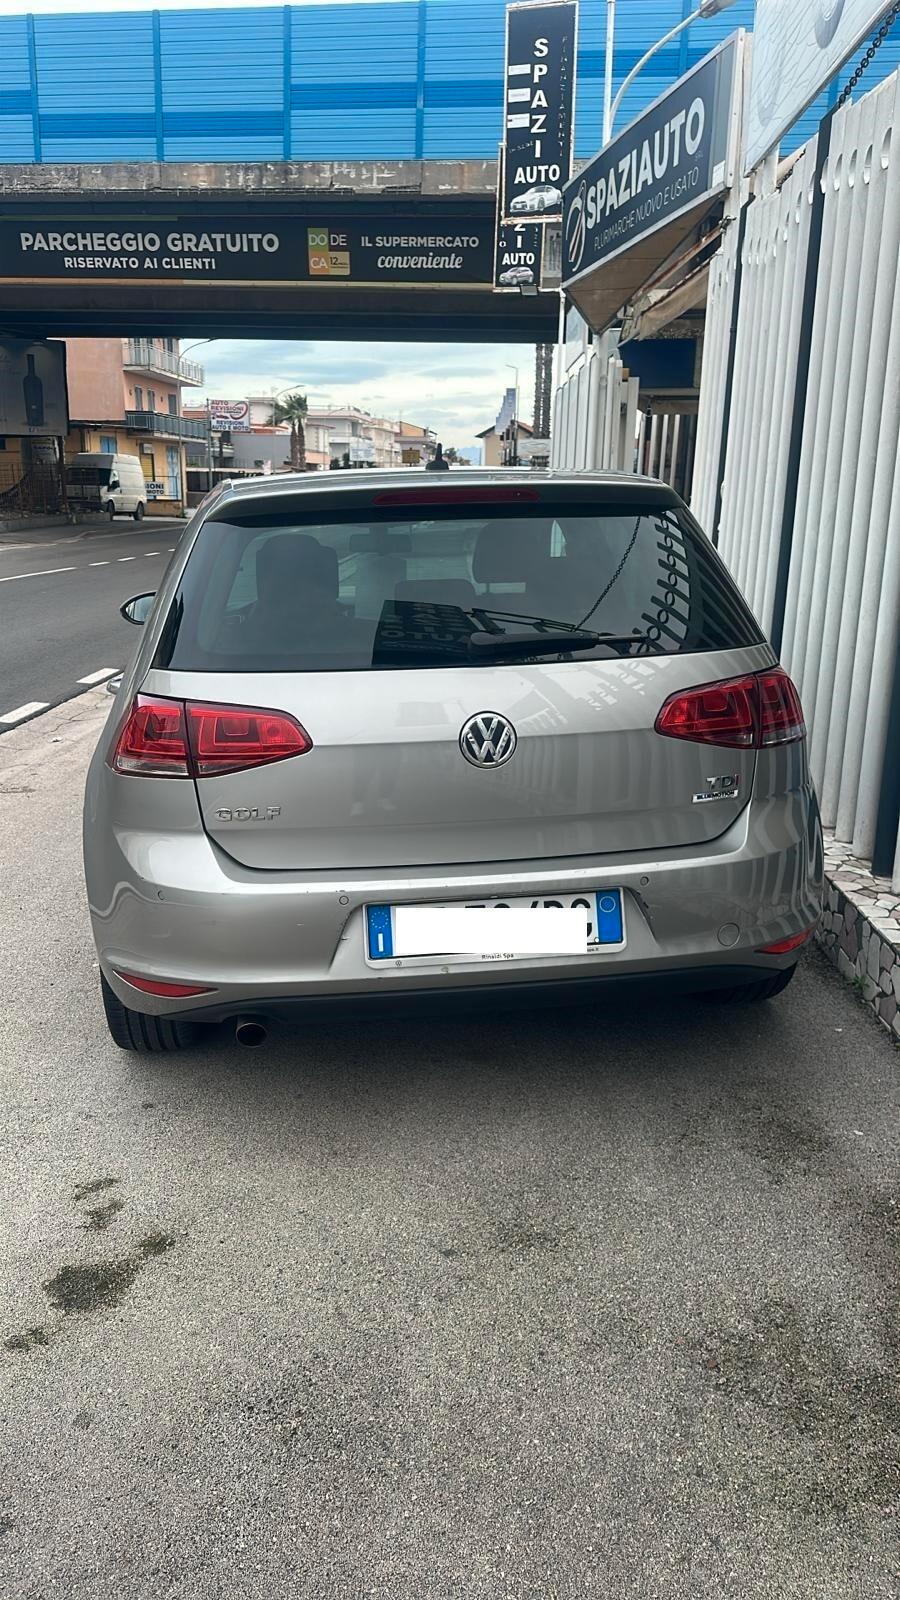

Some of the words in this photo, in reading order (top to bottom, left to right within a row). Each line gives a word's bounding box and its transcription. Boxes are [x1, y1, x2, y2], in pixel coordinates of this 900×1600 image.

[586, 97, 705, 230] SPAZIAUTO
[514, 165, 560, 184] AUTO
[635, 192, 663, 222] NUOVO
[663, 186, 670, 205] E
[670, 166, 699, 200] USATO
[20, 232, 161, 252] PARCHEGGIO
[166, 233, 279, 253] GRATUITO
[330, 234, 347, 246] DE
[361, 236, 373, 248] IL
[375, 235, 479, 248] SUPERMERCATO
[64, 257, 139, 269] RISERVATO
[143, 258, 157, 269] AI
[162, 258, 216, 270] CLIENTI
[377, 252, 463, 270] conveniente
[502, 252, 535, 265] AUTO
[215, 806, 281, 822] GOLF
